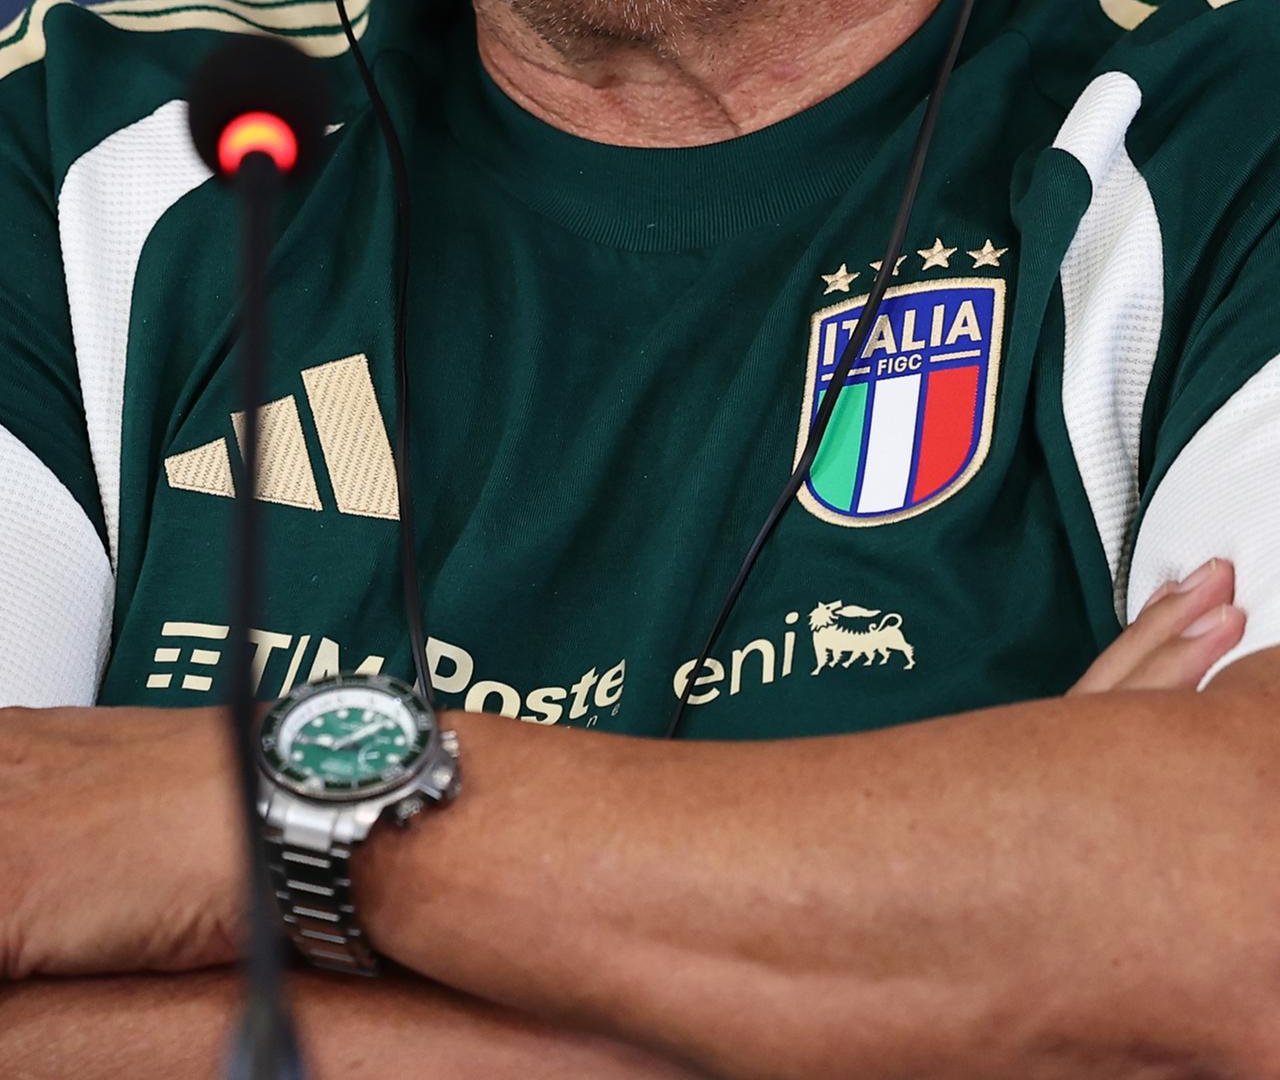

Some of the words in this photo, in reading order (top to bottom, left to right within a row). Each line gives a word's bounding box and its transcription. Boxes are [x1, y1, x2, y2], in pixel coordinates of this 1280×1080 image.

[876, 353, 923, 376] FIGC
[414, 636, 626, 726] Poste
[673, 611, 800, 705] eni
